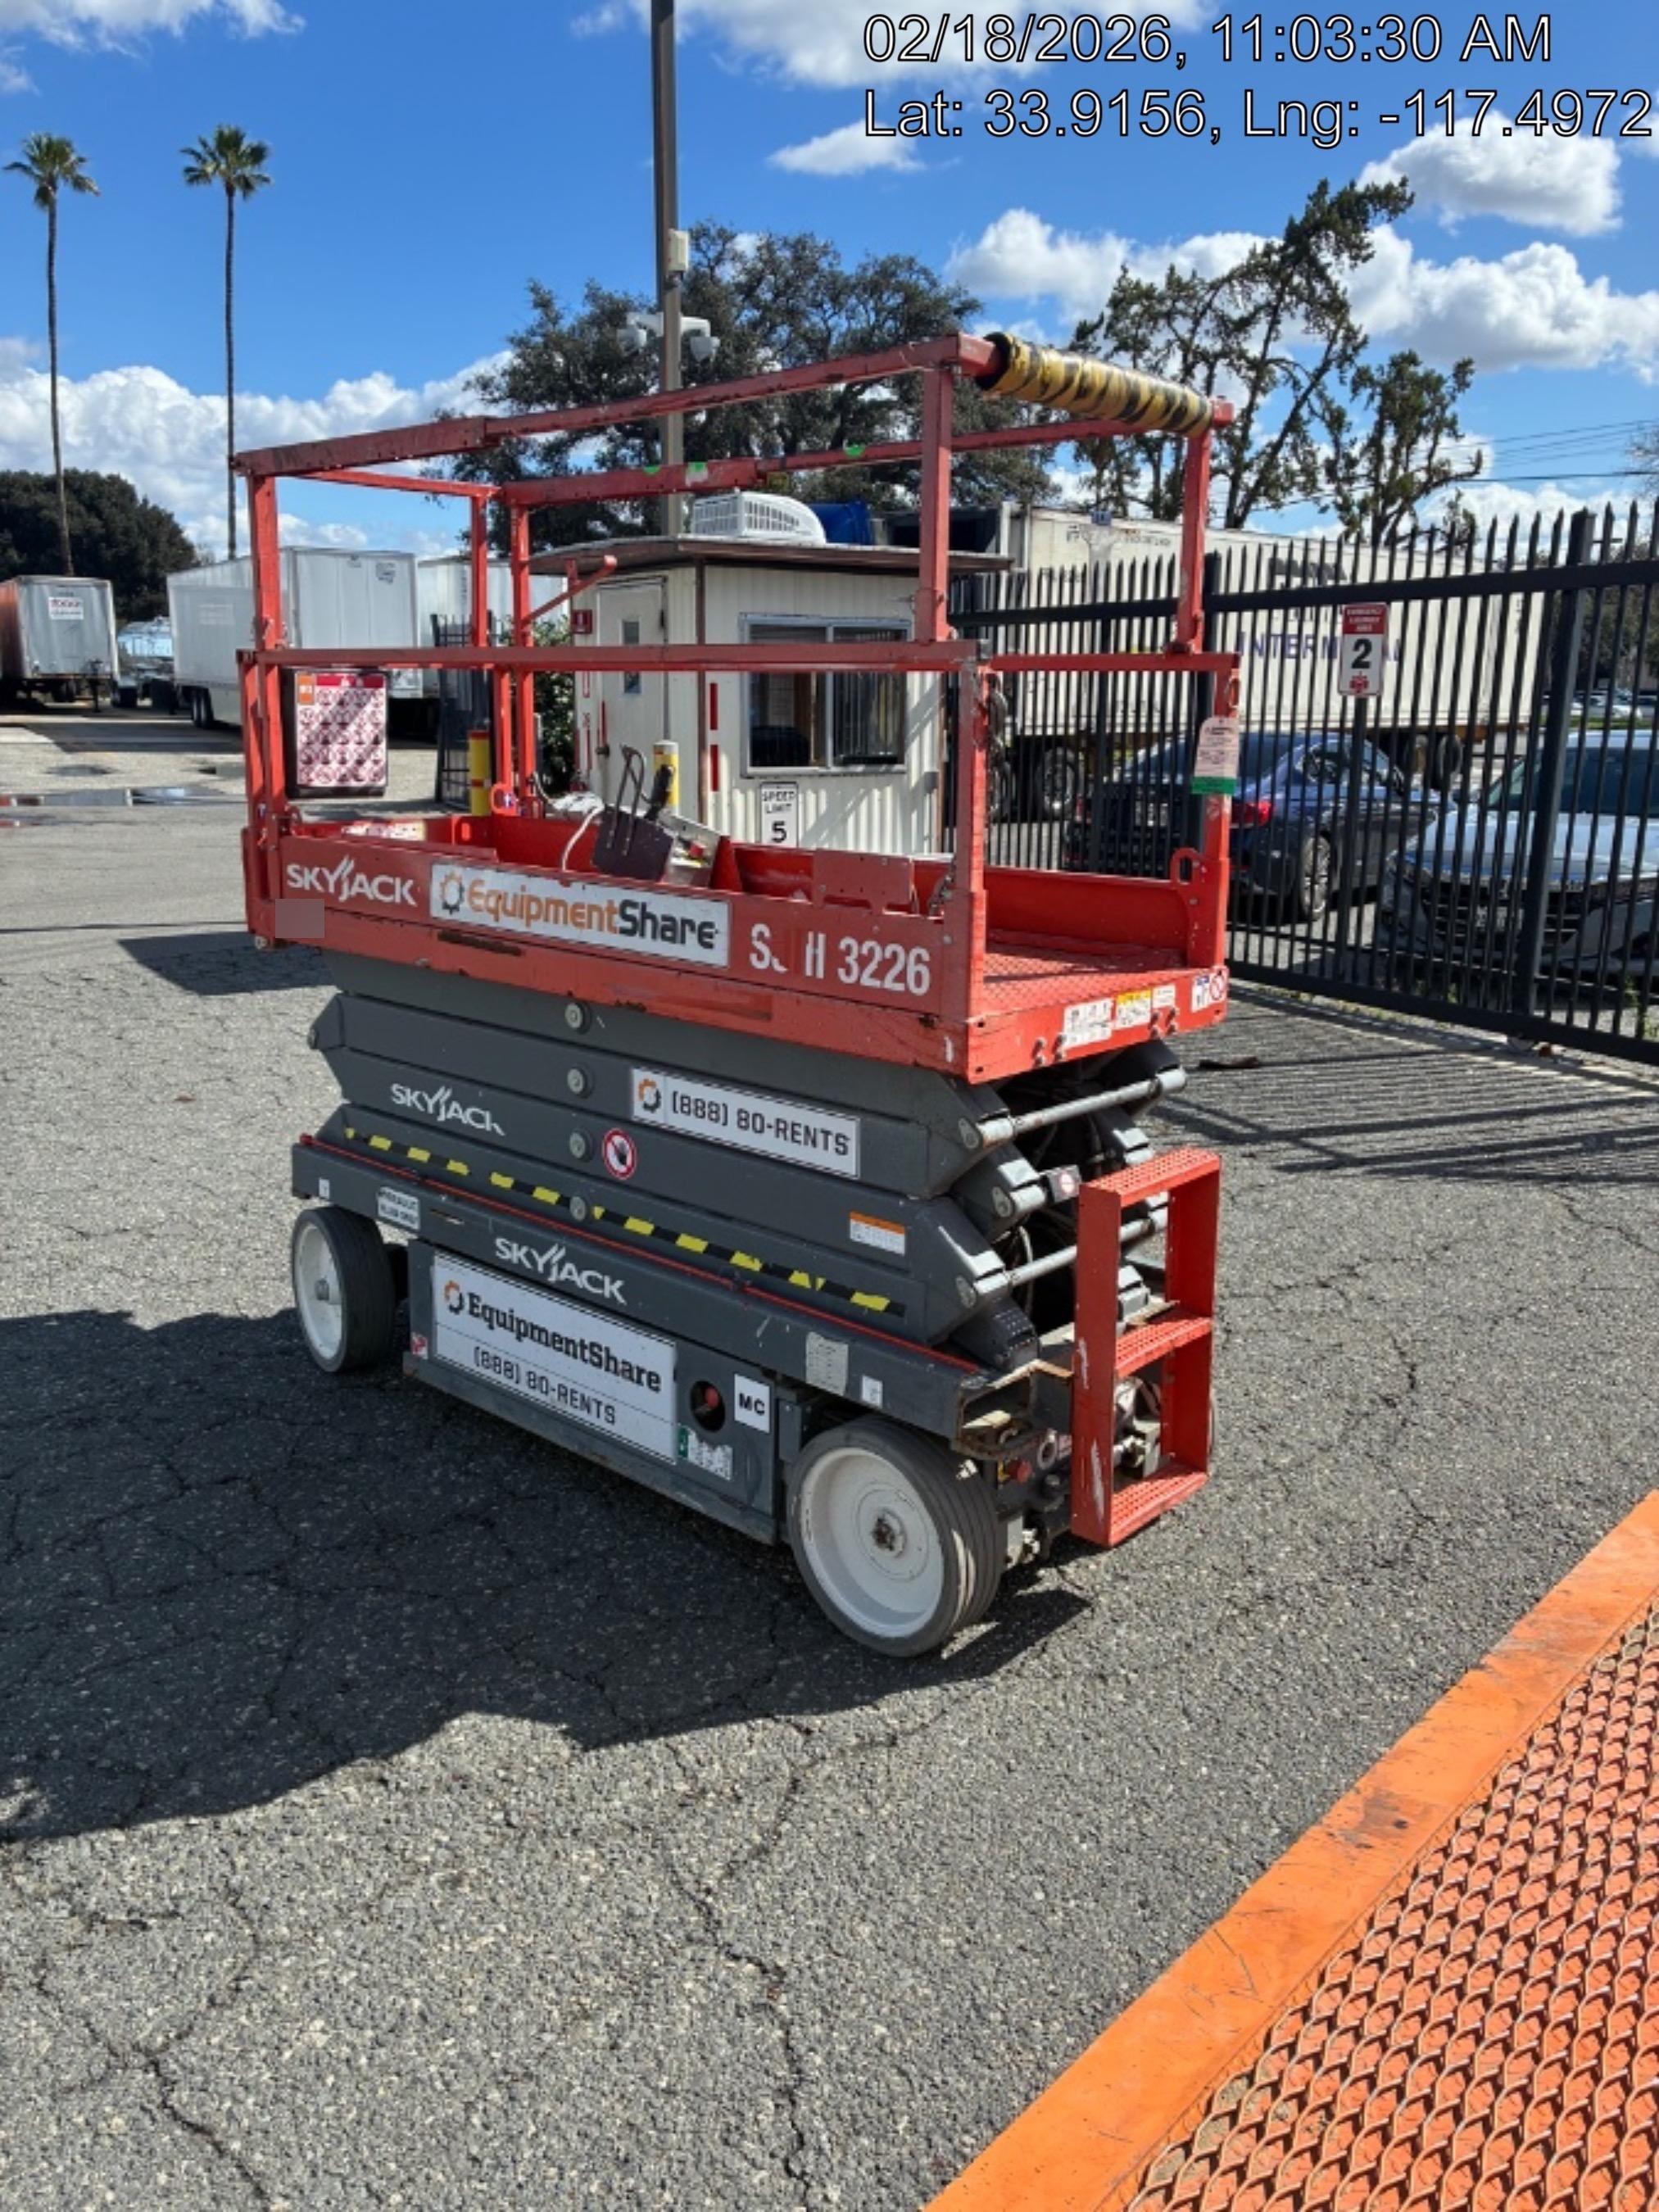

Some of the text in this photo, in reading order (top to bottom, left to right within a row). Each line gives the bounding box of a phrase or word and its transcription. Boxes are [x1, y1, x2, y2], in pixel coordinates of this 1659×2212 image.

[1351, 637, 1372, 669] 2
[772, 821, 786, 843] 5
[287, 854, 419, 907] SKYJACK
[466, 878, 716, 950] EquipmentShare
[836, 936, 931, 997] 3226
[672, 1090, 851, 1156] (888) 80-RENTS
[495, 1237, 628, 1306] SKYJACK
[468, 1292, 662, 1393] EquipmentShare
[474, 1346, 616, 1424] (888) 80-RENTS
[739, 1392, 765, 1416] MC
